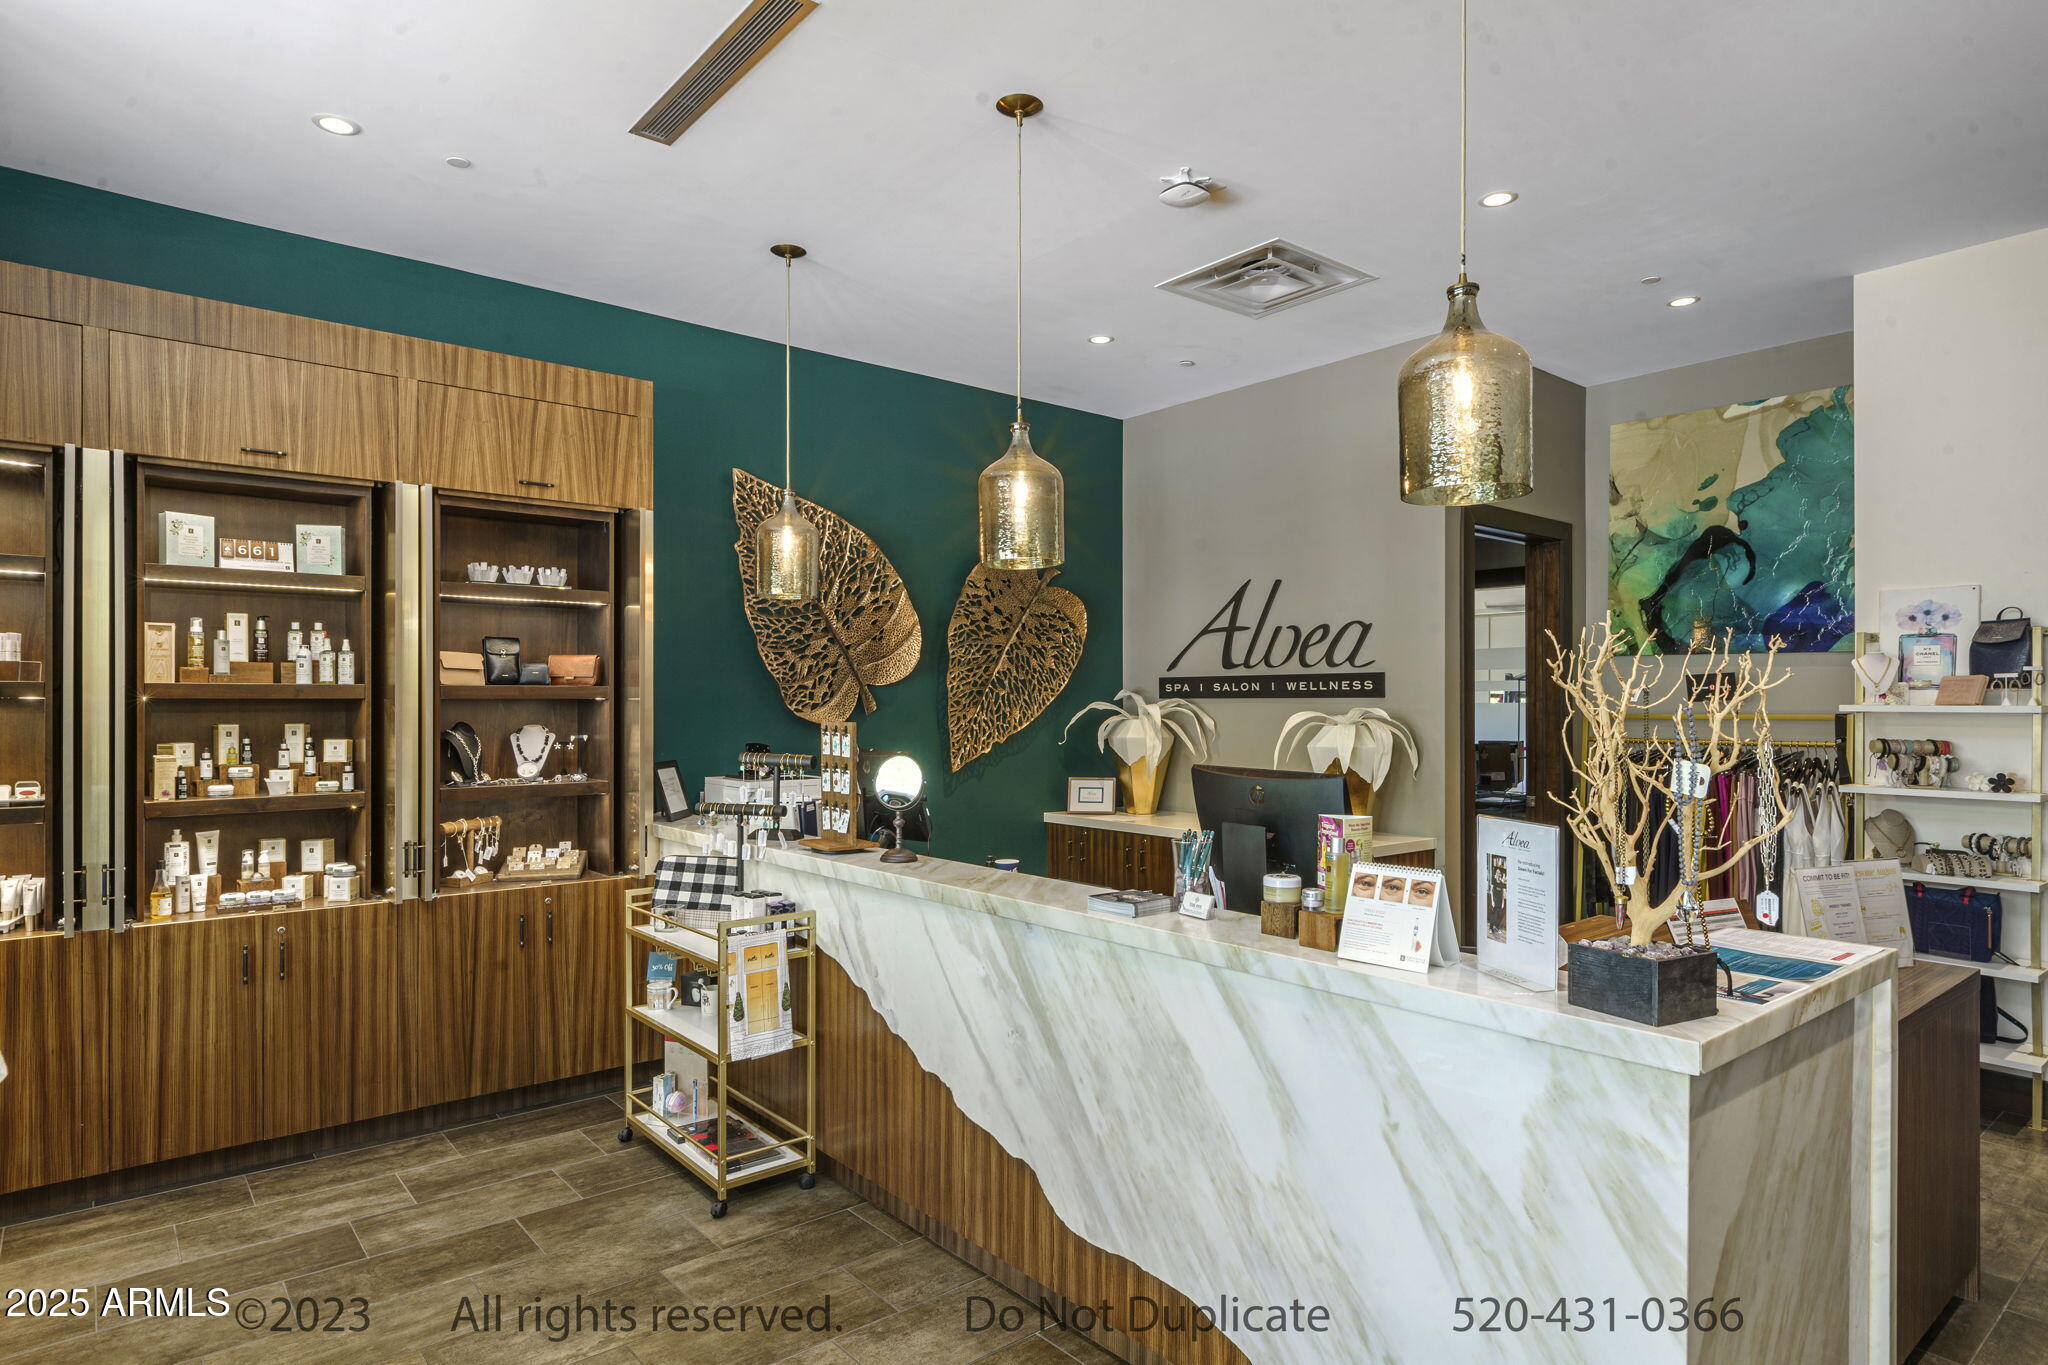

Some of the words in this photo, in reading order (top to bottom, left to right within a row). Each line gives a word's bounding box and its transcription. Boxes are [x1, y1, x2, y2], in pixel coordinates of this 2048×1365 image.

[1167, 578, 1376, 672] Alvea
[1165, 683, 1190, 692] SPA
[1213, 682, 1260, 691] SALON
[1286, 680, 1374, 691] WELLNESS
[1501, 830, 1530, 849] Alvea
[1802, 873, 1824, 882] COMMIT
[1825, 873, 1833, 881] TO
